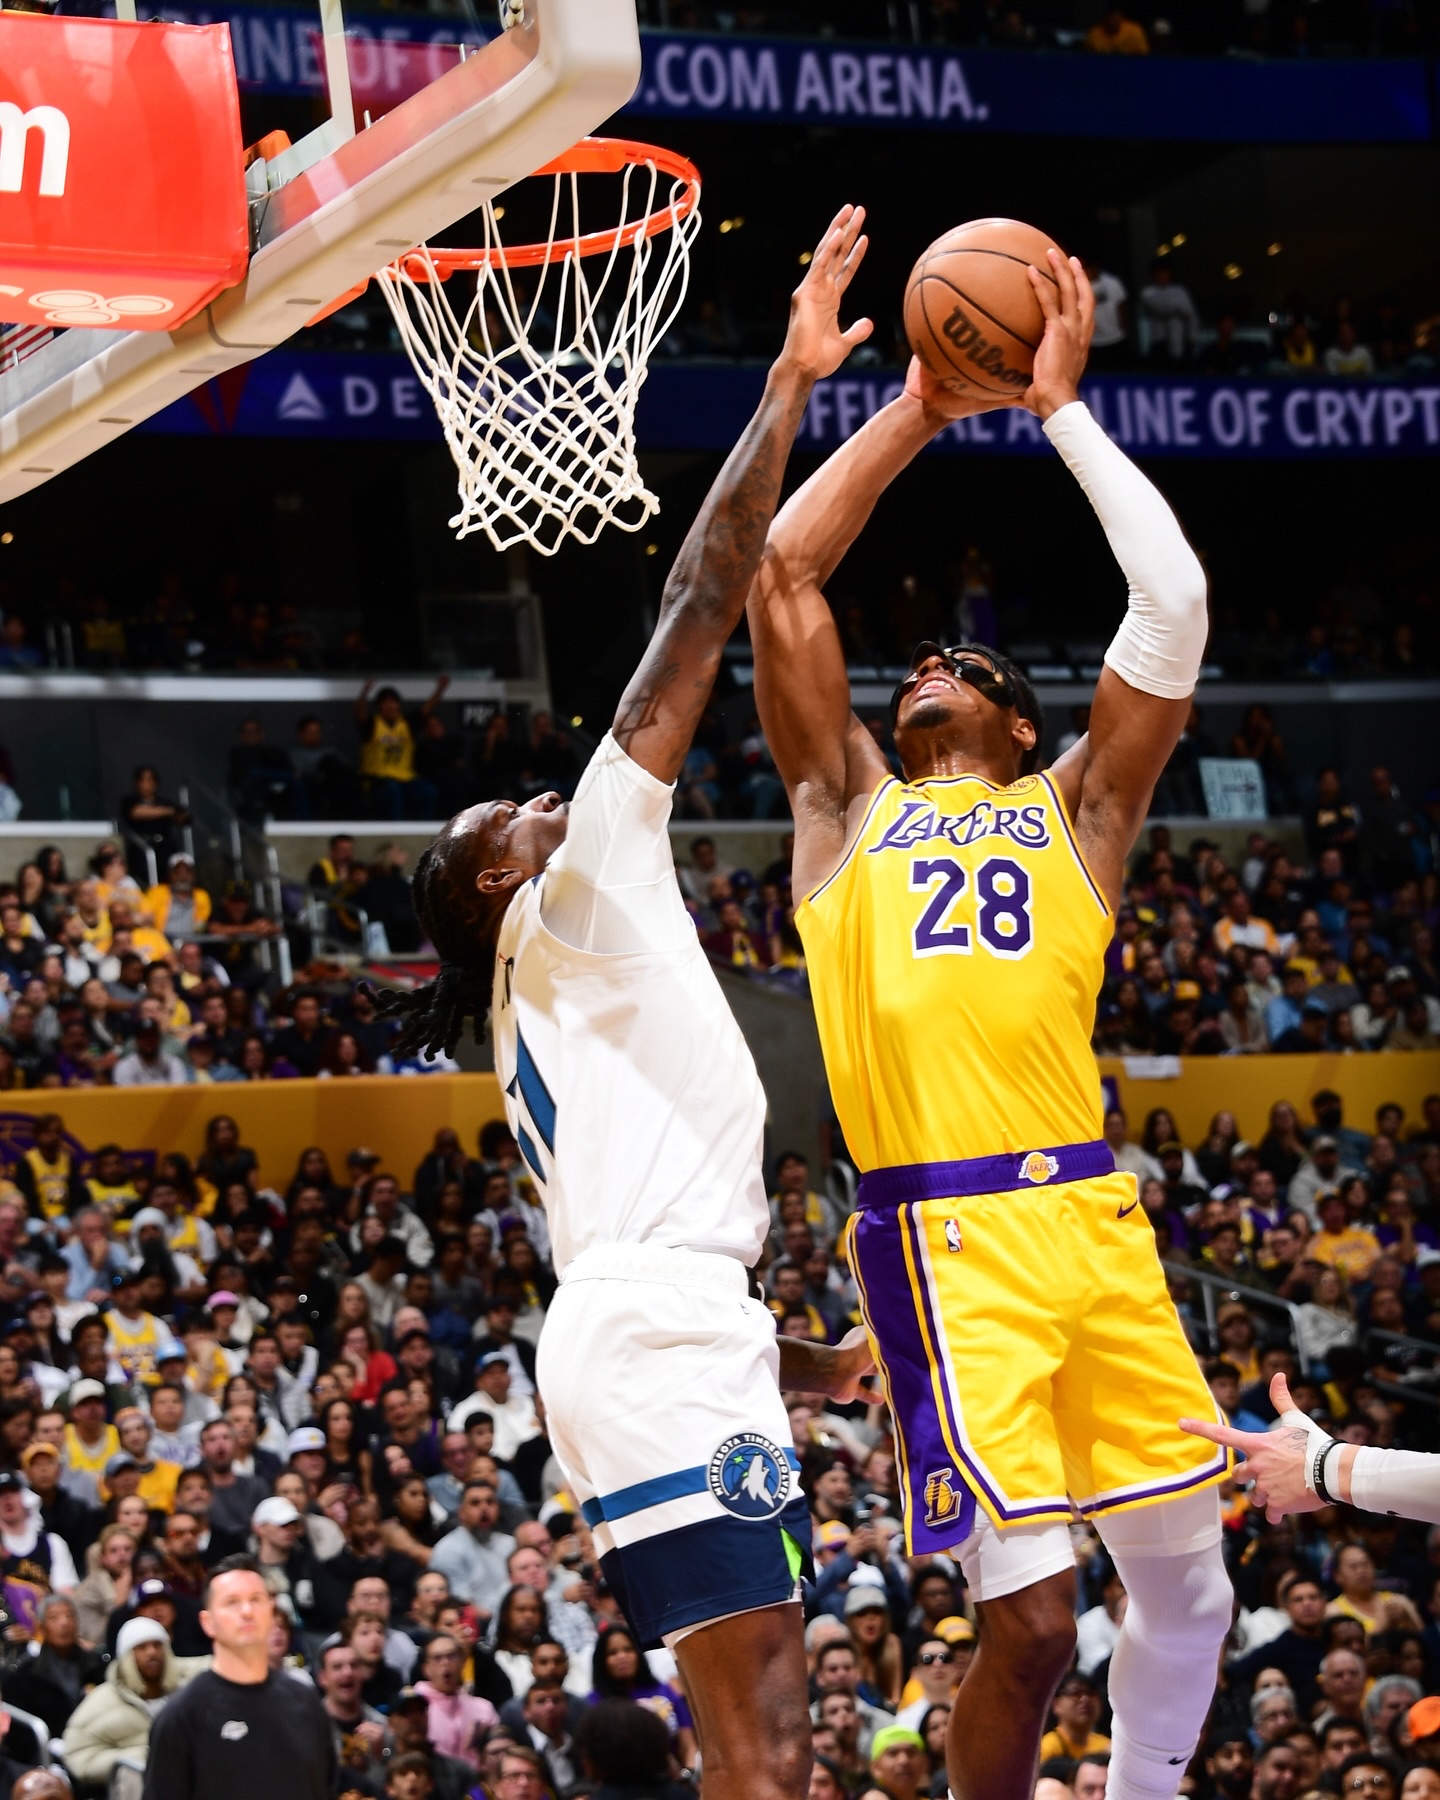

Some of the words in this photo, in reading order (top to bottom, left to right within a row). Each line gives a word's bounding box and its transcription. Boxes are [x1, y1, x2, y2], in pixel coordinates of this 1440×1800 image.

[643, 43, 781, 110] .COM
[794, 52, 989, 121] ARENA.
[1209, 388, 1271, 447] OF
[866, 801, 1051, 854] LAKERS
[911, 856, 1034, 957] 28
[710, 1437, 741, 1497] MINNESOTA
[743, 1434, 790, 1500] TIMBERWOLVES
